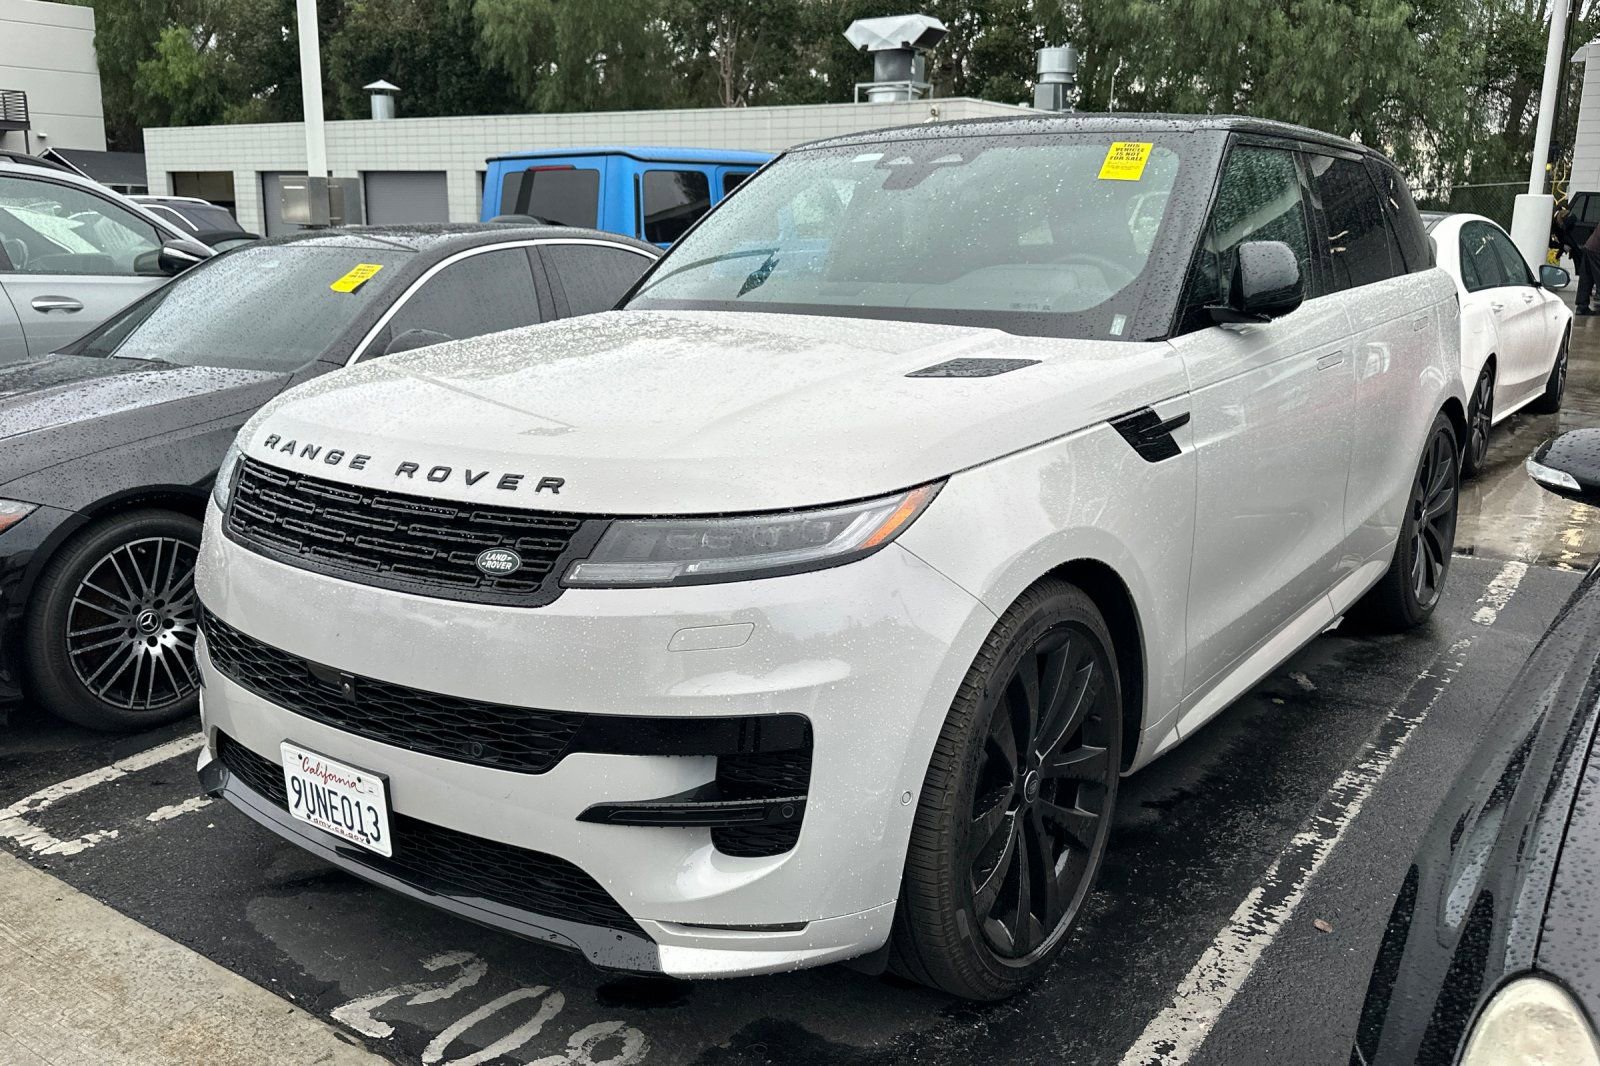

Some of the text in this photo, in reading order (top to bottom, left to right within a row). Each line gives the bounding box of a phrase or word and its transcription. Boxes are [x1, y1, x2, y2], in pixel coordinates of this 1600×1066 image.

[264, 433, 566, 495] RANGE ROVER
[302, 756, 365, 794] California
[291, 775, 382, 842] 9UNE013
[313, 817, 365, 843] dmv.ca.gov
